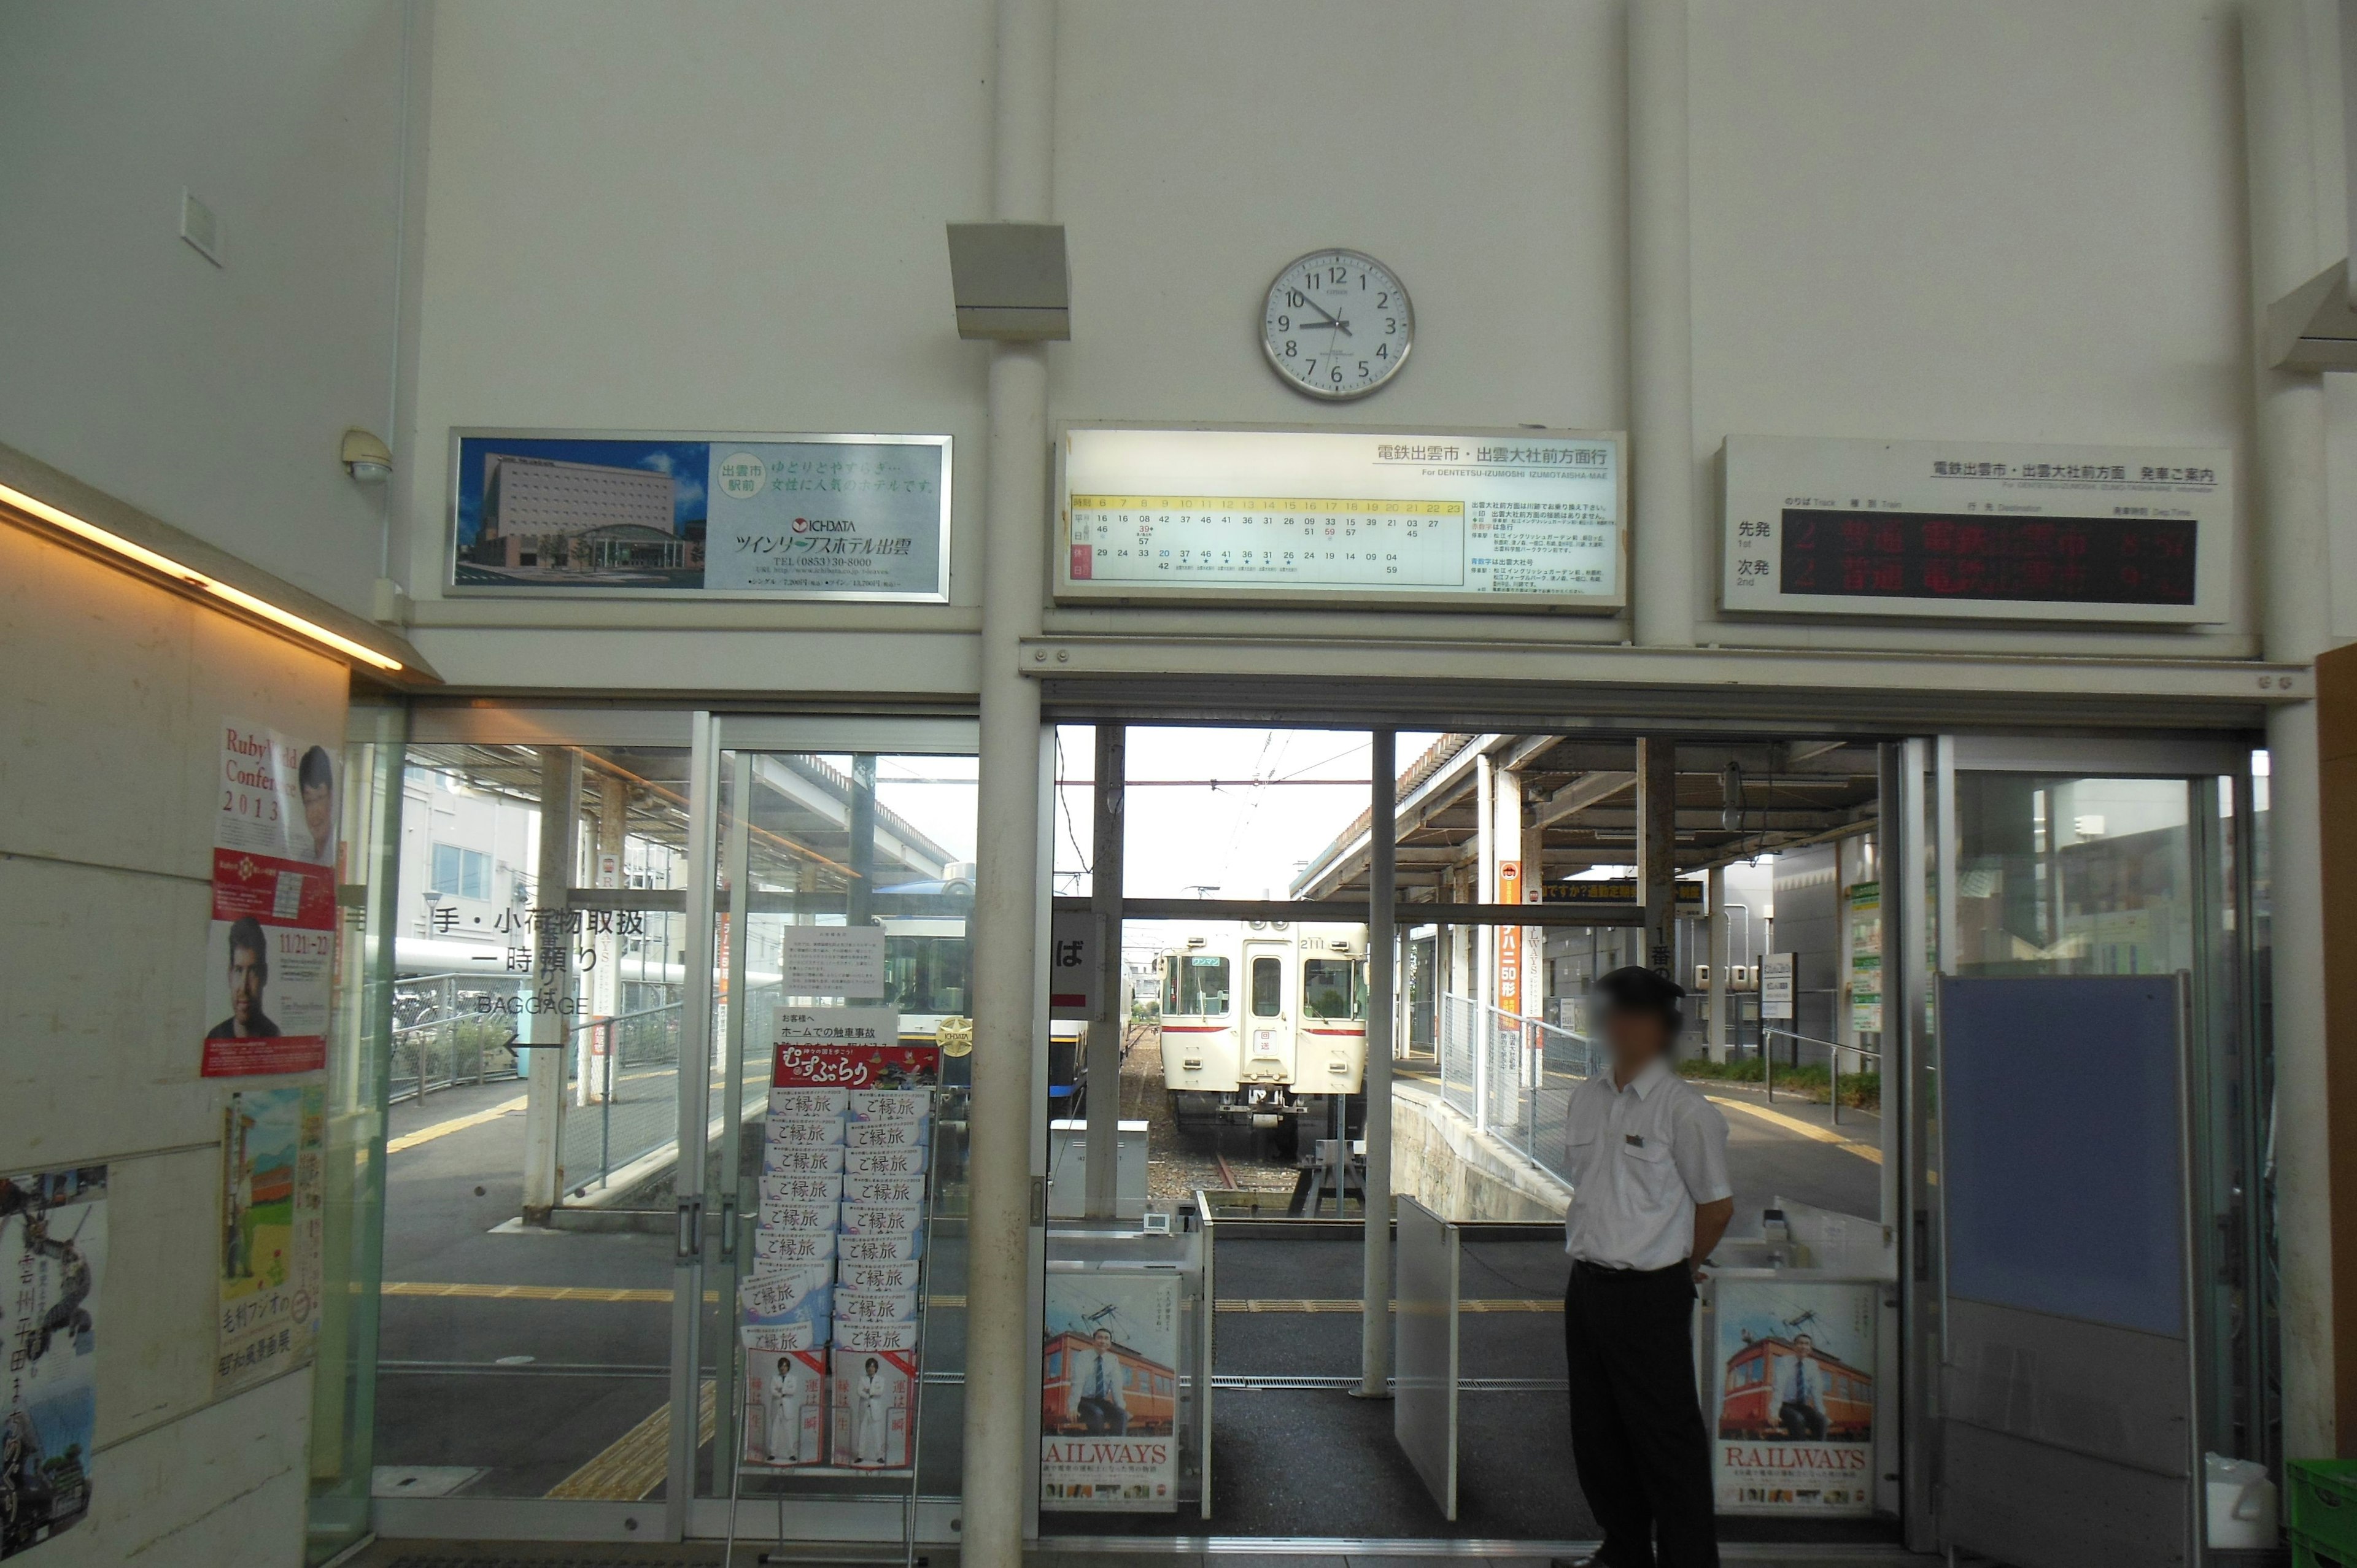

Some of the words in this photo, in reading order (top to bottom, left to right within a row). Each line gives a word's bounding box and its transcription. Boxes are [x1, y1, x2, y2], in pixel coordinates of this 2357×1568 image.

[1305, 273, 1320, 289] 11
[1328, 267, 1347, 284] 12
[1360, 275, 1366, 290] 1
[1286, 292, 1304, 307] 10
[1377, 292, 1388, 309] 2
[1278, 315, 1290, 331] 9
[1385, 318, 1396, 334] 3
[1286, 341, 1297, 357] 8
[1376, 344, 1388, 359] 4
[1306, 359, 1317, 376] 7
[1331, 366, 1342, 382] 6
[1358, 361, 1369, 377] 5
[1378, 445, 1608, 465] 電鉄出雲市・出雲大社前方面行
[722, 465, 762, 477] 出雲市
[1933, 462, 2125, 480] 電鉄出雲市・出雲大社前方面
[2141, 467, 2215, 482] 発車ご案内
[729, 479, 754, 491] 駅前
[1785, 498, 1811, 506] のりば
[1814, 498, 1835, 507] Track
[1739, 520, 1770, 537] 先発
[1738, 559, 1769, 576] 次発
[1301, 940, 1324, 949] 2111
[1193, 957, 1220, 966] ワンマン
[479, 997, 589, 1014] BAGGAGE
[781, 1027, 875, 1038] ホームでの触車事故
[1260, 1031, 1271, 1051] 回送
[786, 1095, 831, 1112] ご縁旅
[867, 1098, 915, 1115] ご縁旅
[780, 1124, 825, 1141] ご縁旅
[859, 1127, 905, 1145] ご縁旅
[783, 1153, 828, 1169] ご縁旅
[859, 1155, 907, 1172] ご縁旅
[780, 1181, 827, 1197] ご縁旅
[861, 1184, 910, 1200] ご縁旅
[771, 1210, 818, 1226] ご縁旅
[857, 1213, 905, 1229] ご縁旅
[767, 1238, 815, 1256] ご縁旅
[849, 1242, 897, 1259] ご縁旅
[855, 1269, 903, 1286] ご縁旅
[751, 1284, 794, 1305] ご縁旅
[848, 1300, 895, 1317] ご縁旅
[851, 1331, 900, 1348] ご縁旅
[1042, 1443, 1167, 1465] AILWAYS
[1725, 1446, 1866, 1470] RAILWAYS
